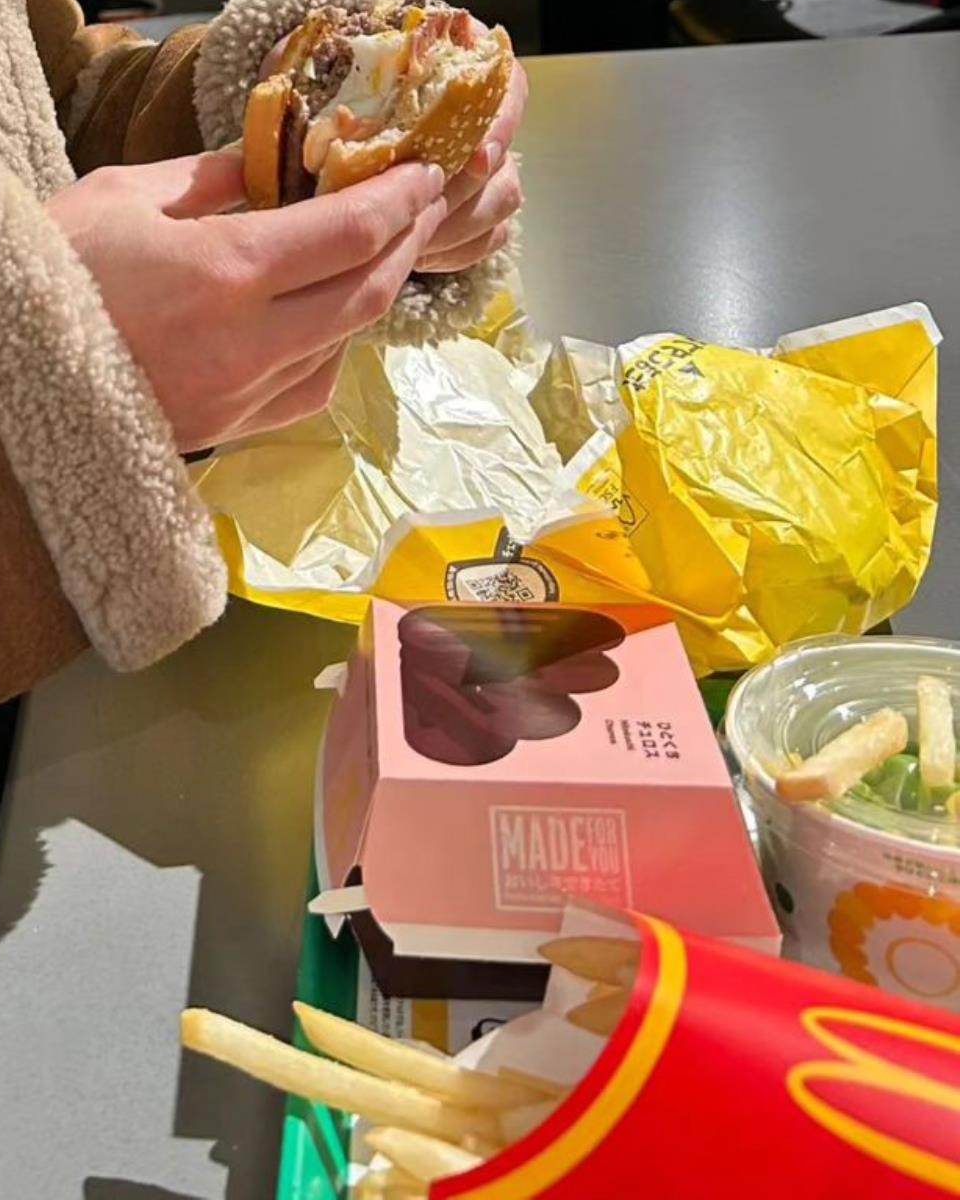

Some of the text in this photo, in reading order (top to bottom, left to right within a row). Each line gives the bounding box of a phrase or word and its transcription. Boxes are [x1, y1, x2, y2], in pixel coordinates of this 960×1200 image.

[500, 813, 588, 873] MADE
[586, 816, 617, 845] FOR
[591, 847, 621, 875] YOU
